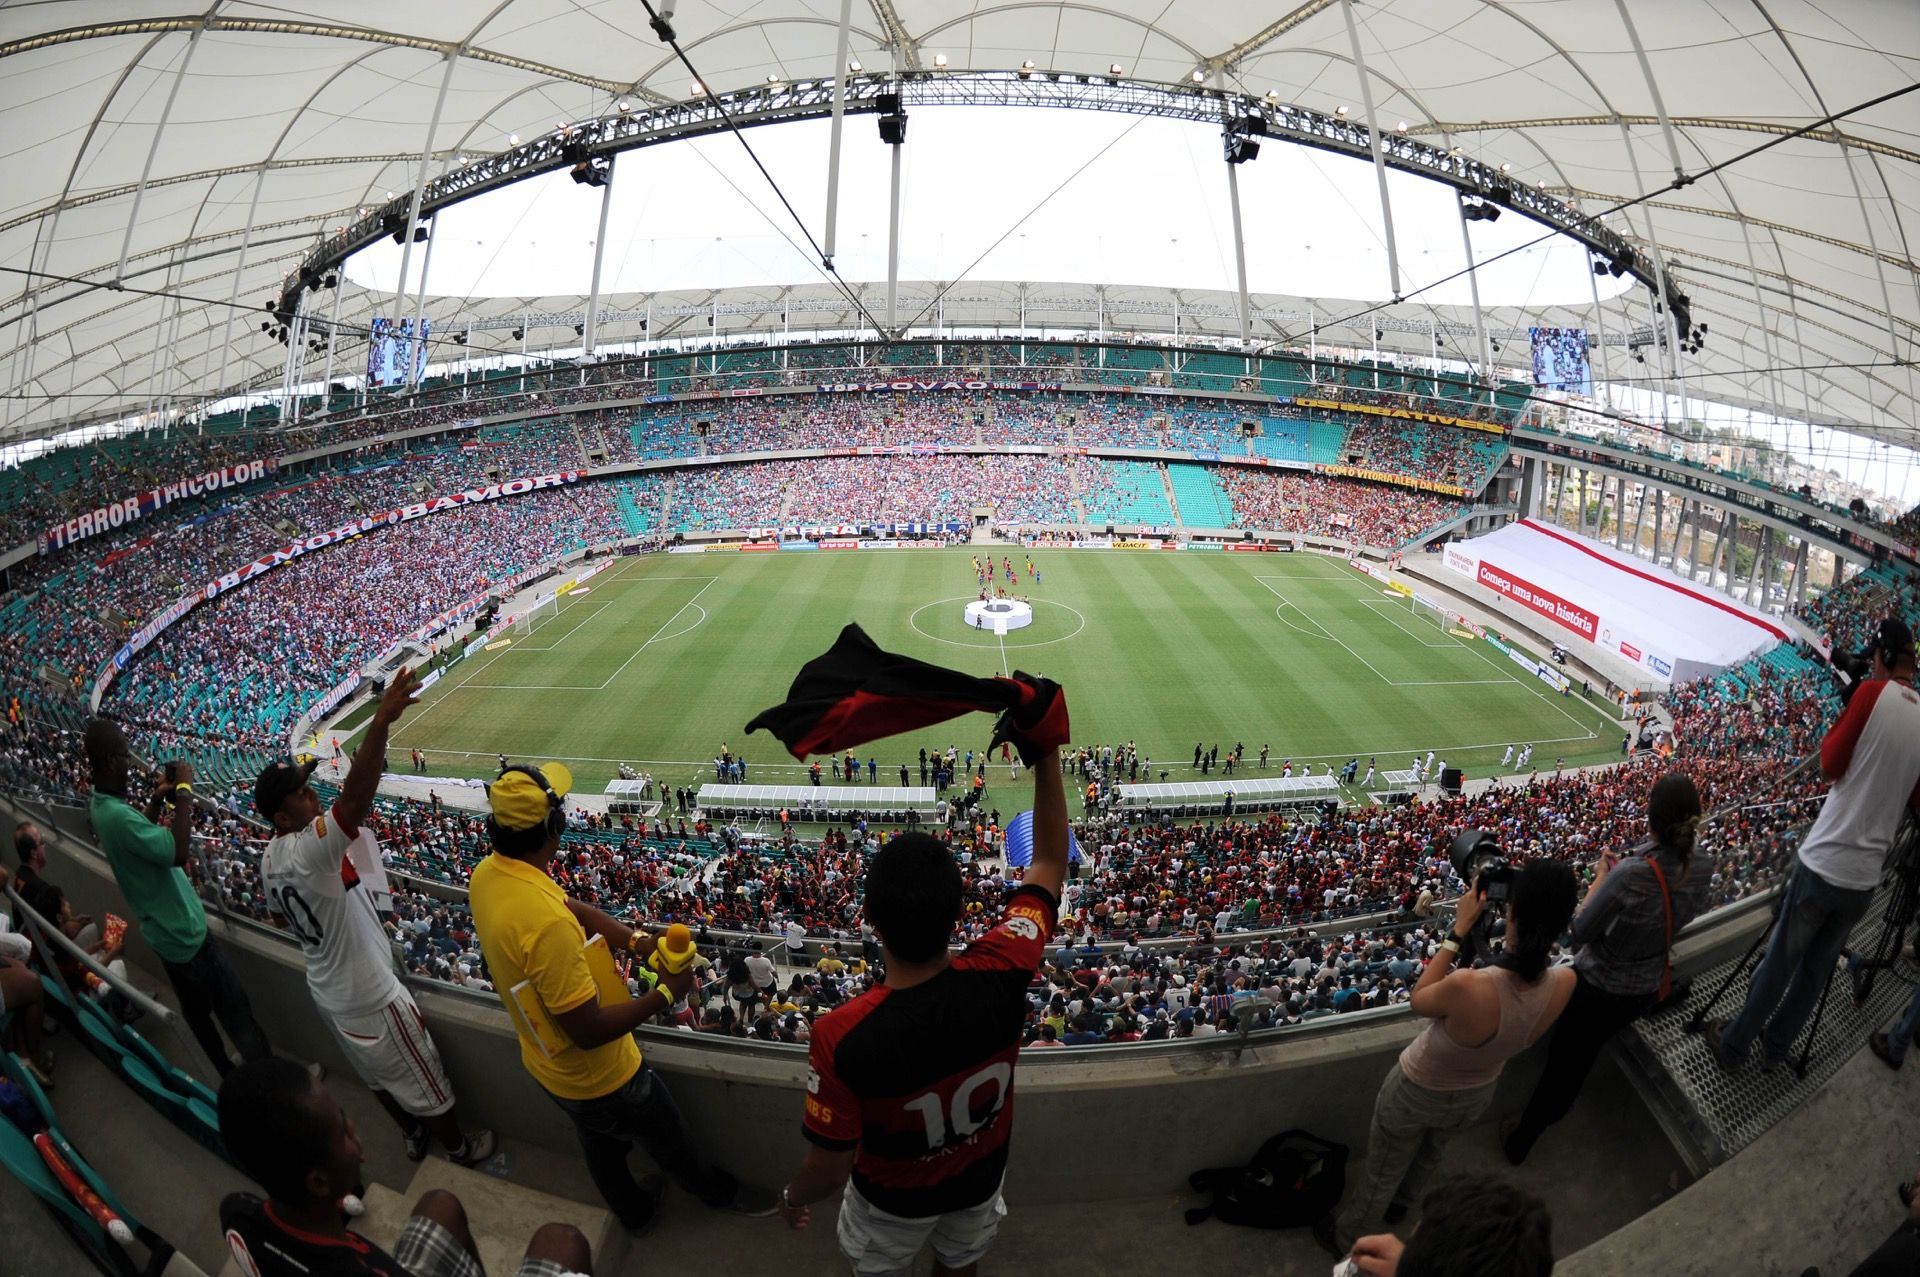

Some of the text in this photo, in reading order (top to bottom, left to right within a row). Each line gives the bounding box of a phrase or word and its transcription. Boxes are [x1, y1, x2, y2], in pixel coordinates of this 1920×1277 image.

[52, 460, 265, 549] TERROR TRICOLOR
[400, 474, 564, 522] BAMOR
[1325, 465, 1348, 475] COM
[1358, 469, 1393, 484] VITORIA
[1419, 480, 1434, 490] DA
[1434, 483, 1463, 496] MORTE
[217, 523, 361, 592] BAMOR
[1480, 566, 1593, 634] Começa uma nova história
[1485, 634, 1510, 655] PETROBRAS
[320, 674, 359, 715] FEMININO
[1176, 996, 1185, 1008] 9
[903, 1062, 1011, 1149] 10
